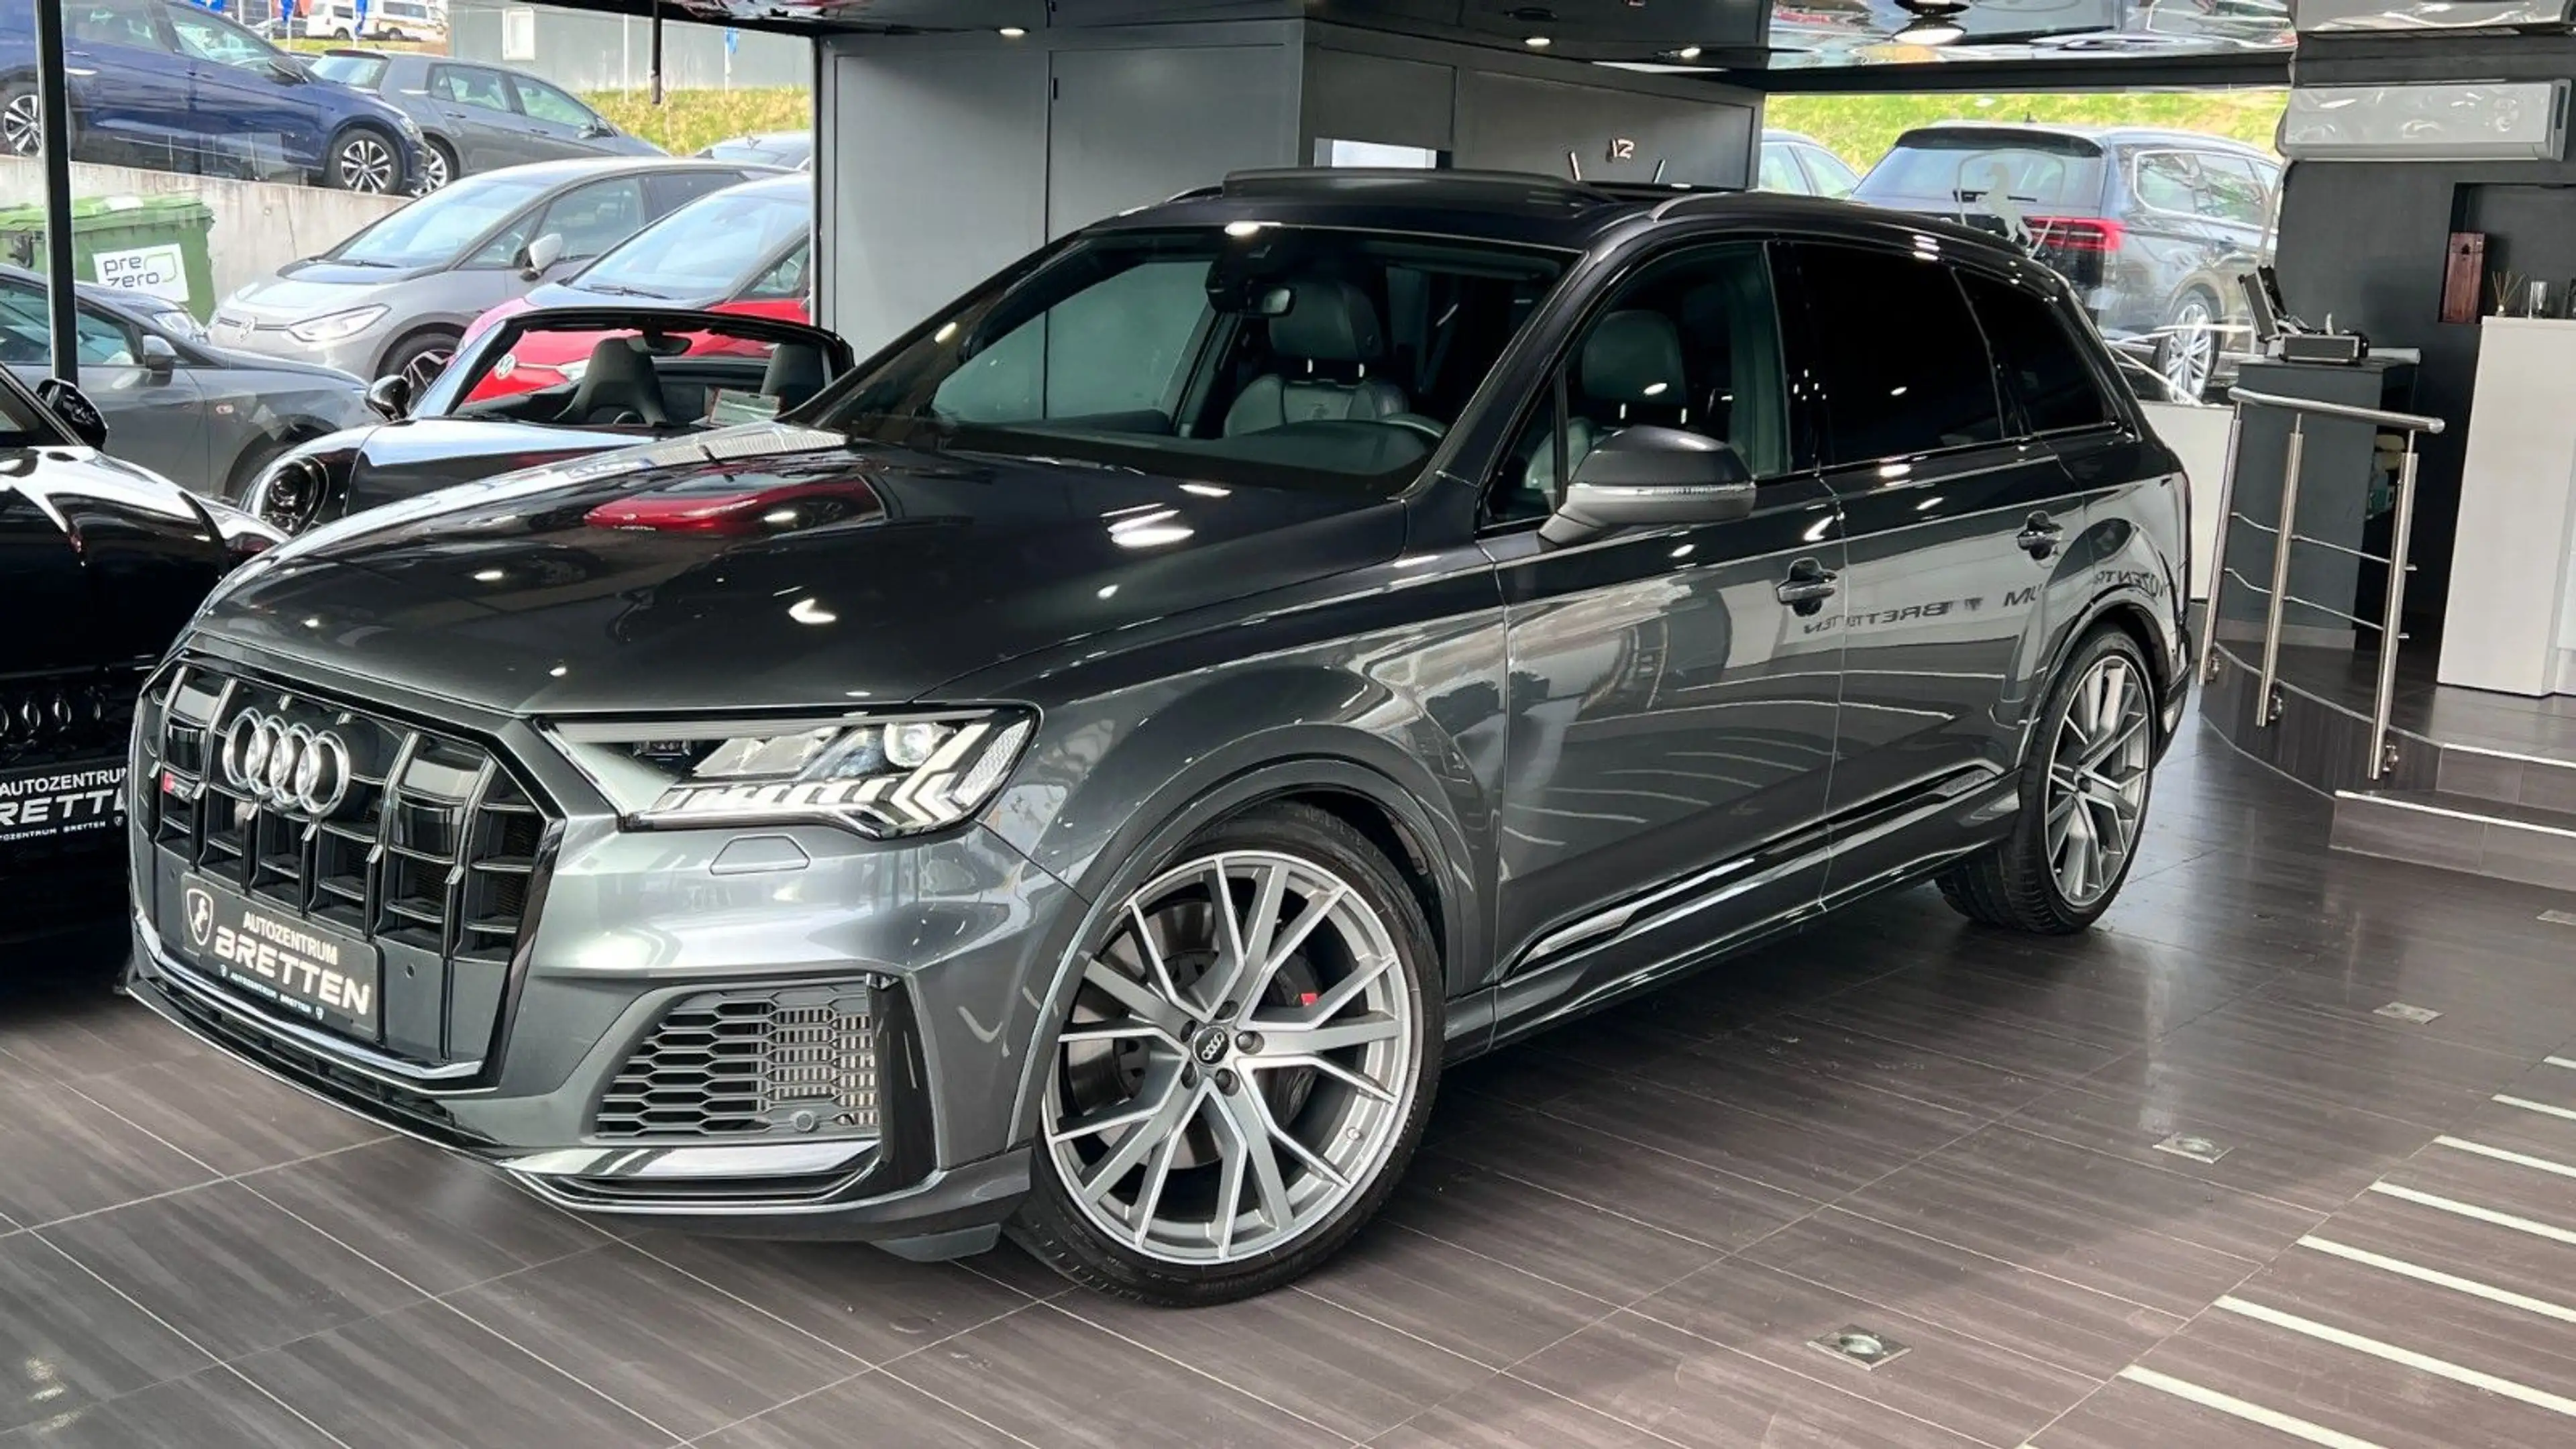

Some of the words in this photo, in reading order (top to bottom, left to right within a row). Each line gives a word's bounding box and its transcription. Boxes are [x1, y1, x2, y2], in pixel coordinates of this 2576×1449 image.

[1613, 138, 1635, 159] 12
[103, 256, 142, 276] pre
[0, 788, 126, 825] RETT
[0, 828, 57, 841] OZENTRUM
[243, 911, 338, 965] AUTOZENTRUM
[214, 926, 371, 1016] BRETTEN
